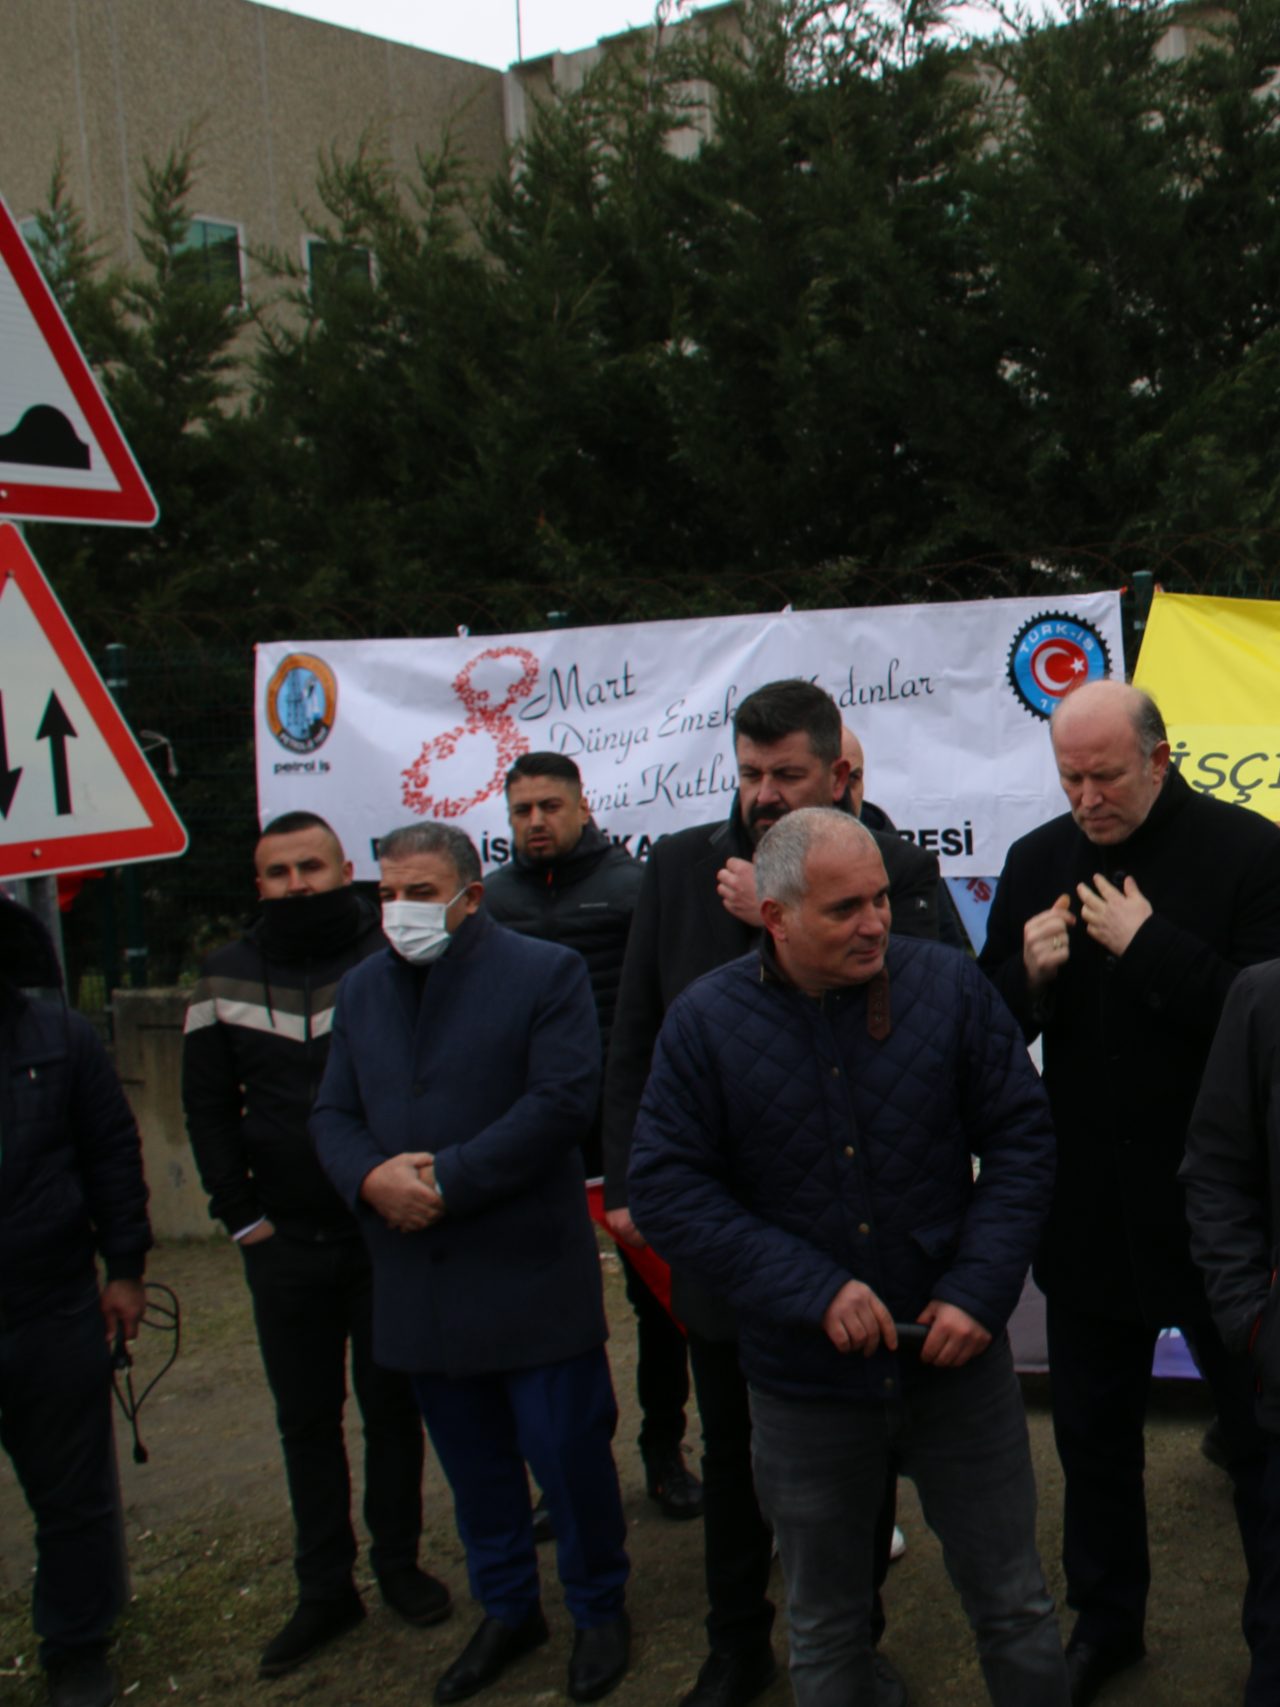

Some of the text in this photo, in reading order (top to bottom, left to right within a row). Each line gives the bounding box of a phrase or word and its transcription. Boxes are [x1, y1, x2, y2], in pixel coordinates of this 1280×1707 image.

[518, 660, 637, 721] Mart
[550, 658, 936, 765] Dünya Emek dınlar
[586, 753, 741, 813] ünü Kutlu
